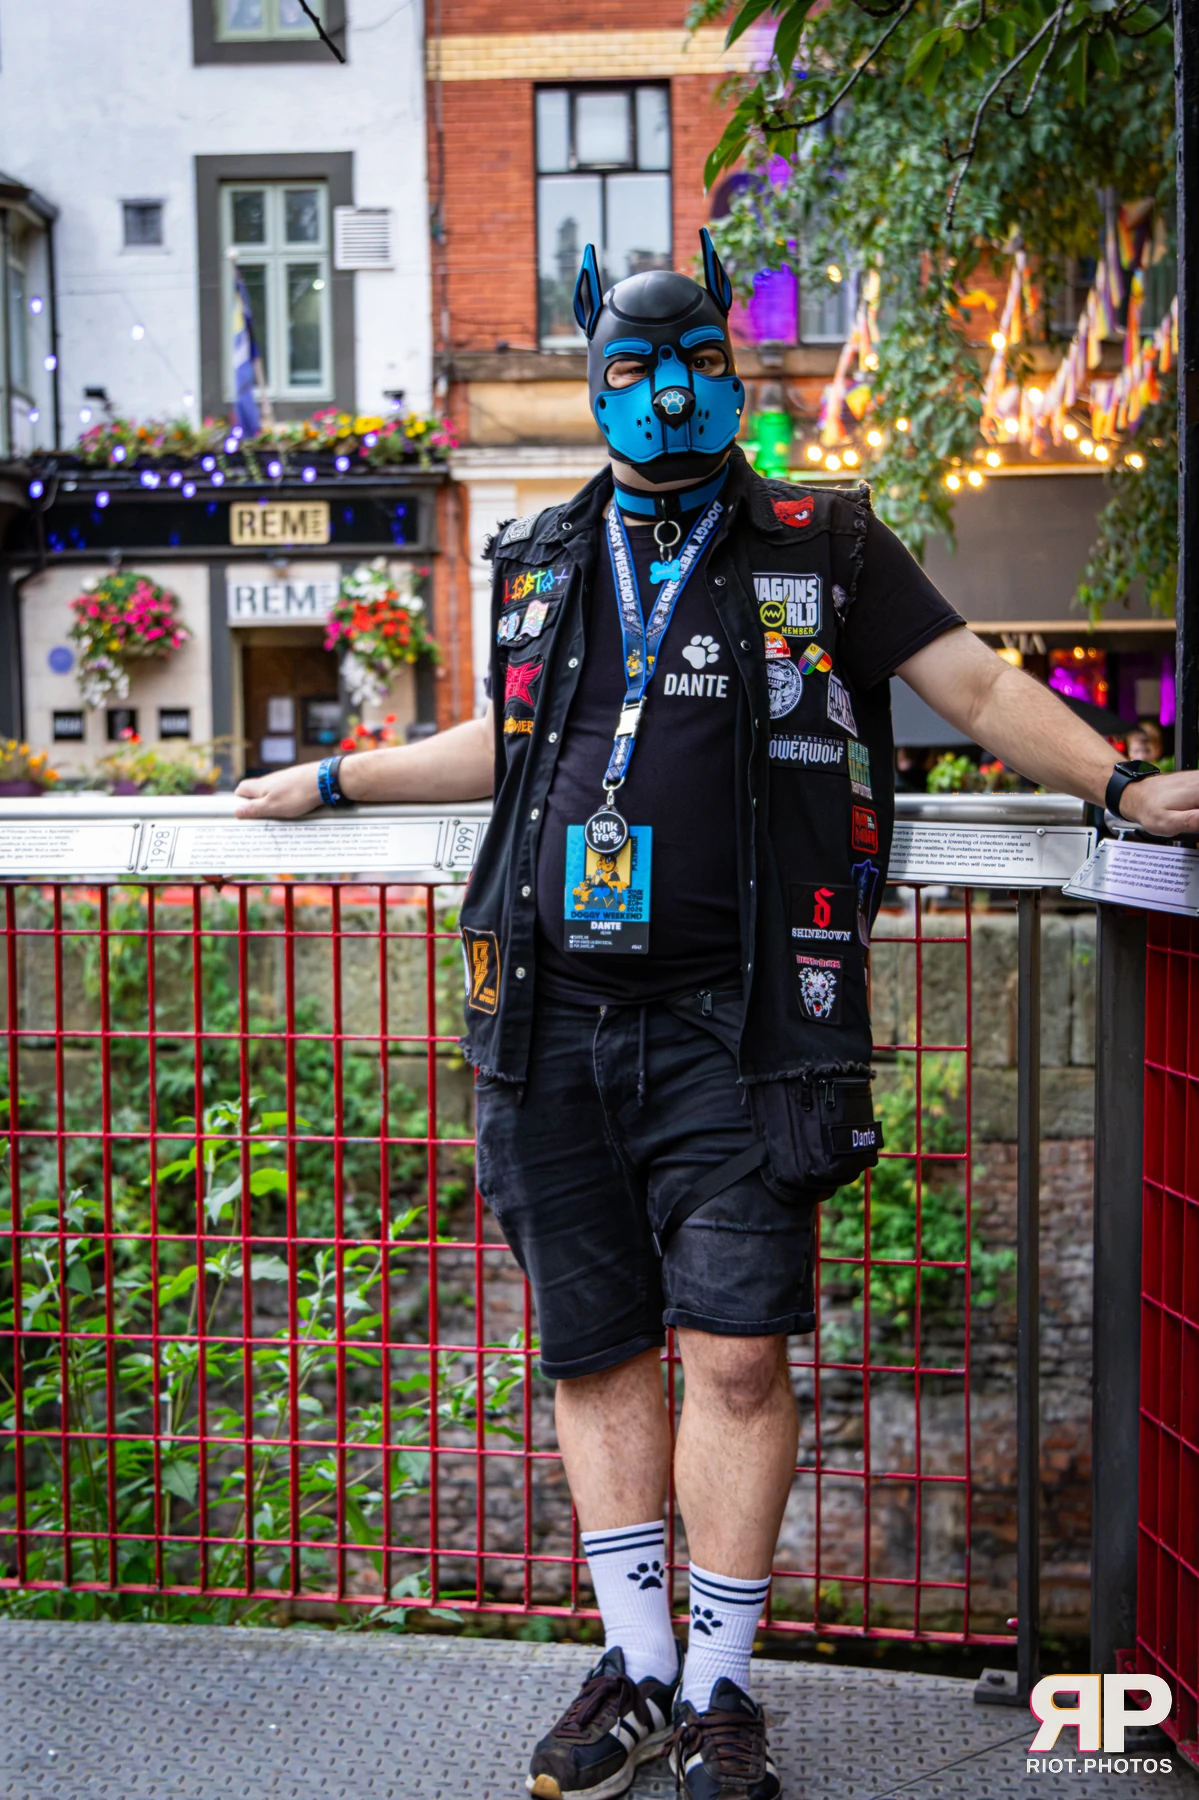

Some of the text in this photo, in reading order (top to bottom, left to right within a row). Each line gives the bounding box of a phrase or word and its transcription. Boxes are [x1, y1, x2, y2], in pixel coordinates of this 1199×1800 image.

[237, 508, 307, 538] REM
[607, 508, 623, 547] DOGGY
[694, 500, 724, 544] DOGGY
[613, 545, 635, 602] WEEKEND
[660, 544, 699, 602] WEEEND
[235, 585, 316, 613] REM
[781, 626, 814, 635] MEMBER
[663, 673, 730, 698] DANTE
[769, 739, 844, 766] OWERWOLF
[592, 821, 618, 833] kink
[592, 830, 618, 844] tree
[150, 830, 170, 863] 1998
[454, 827, 475, 860] 1999
[570, 911, 643, 920] DOGGY WEEKEND
[590, 921, 622, 930] DANTE
[791, 928, 852, 941] SHINEDOWN
[852, 1127, 876, 1148] Dante
